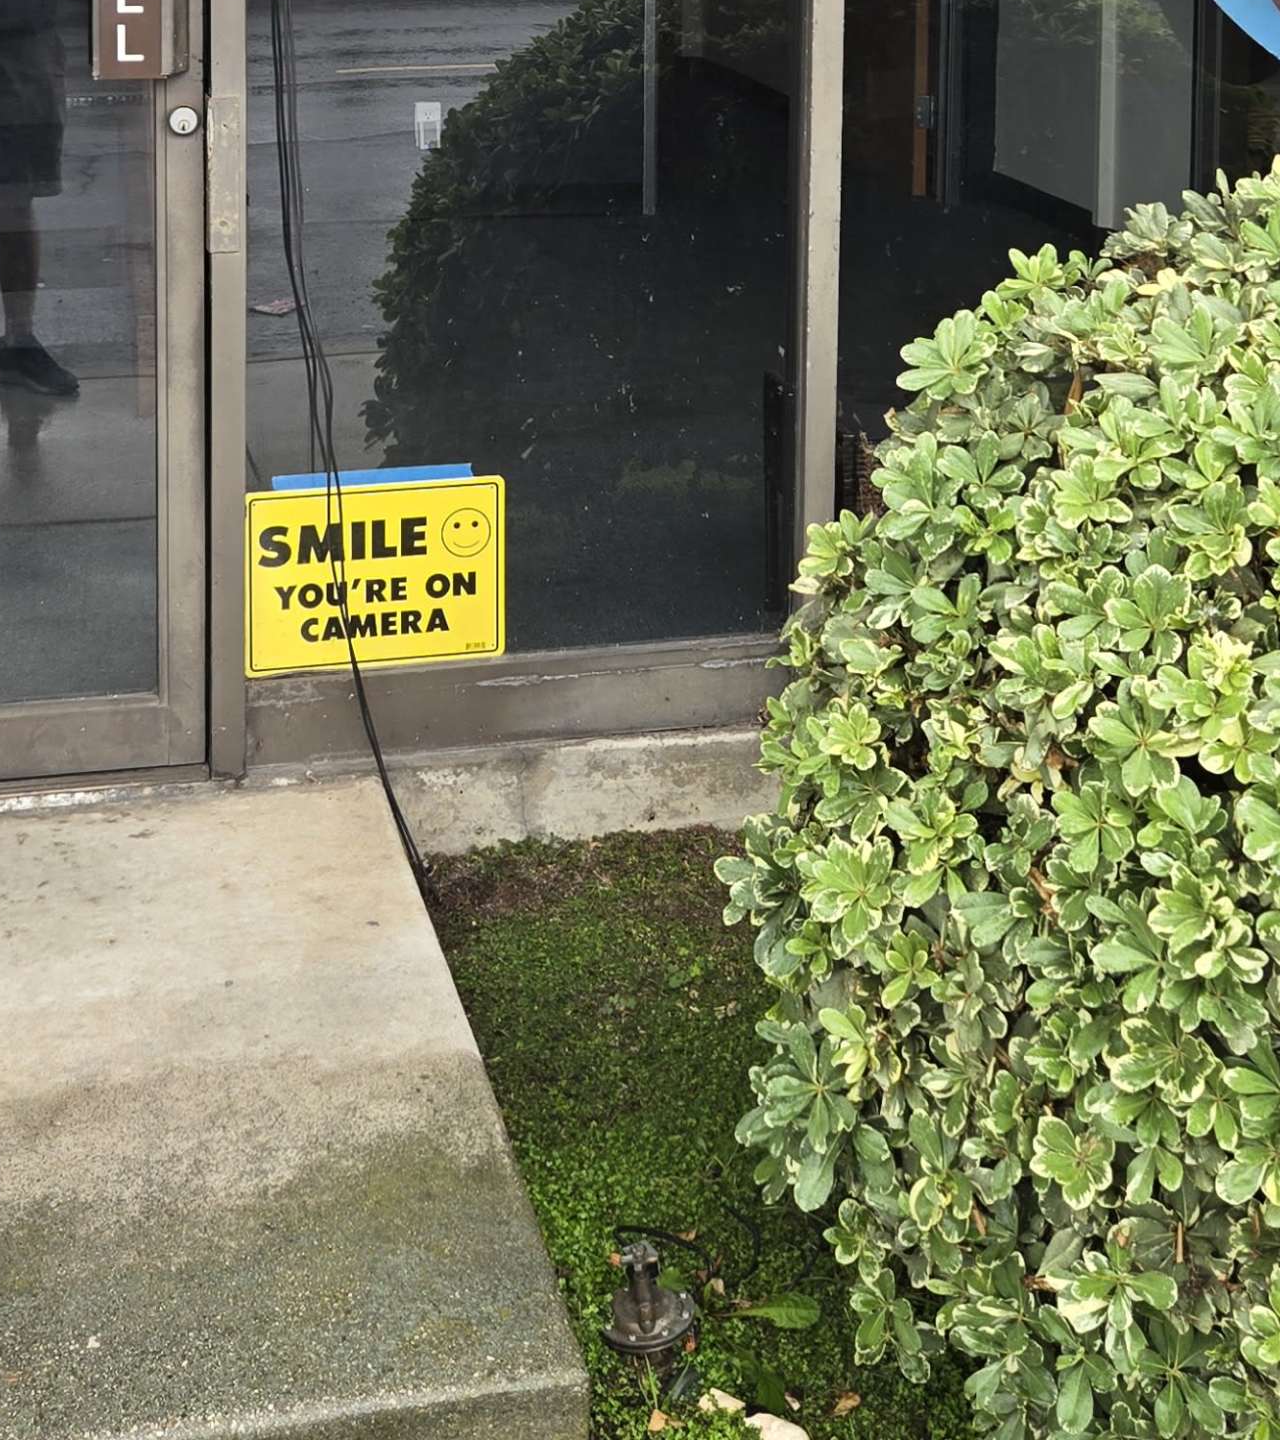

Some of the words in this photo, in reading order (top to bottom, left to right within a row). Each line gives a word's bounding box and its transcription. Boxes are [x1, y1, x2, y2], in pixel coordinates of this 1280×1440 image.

[258, 516, 428, 568] SMILE
[275, 576, 408, 610] YOU'RE
[425, 571, 477, 599] ON
[300, 608, 450, 643] CAMERA
